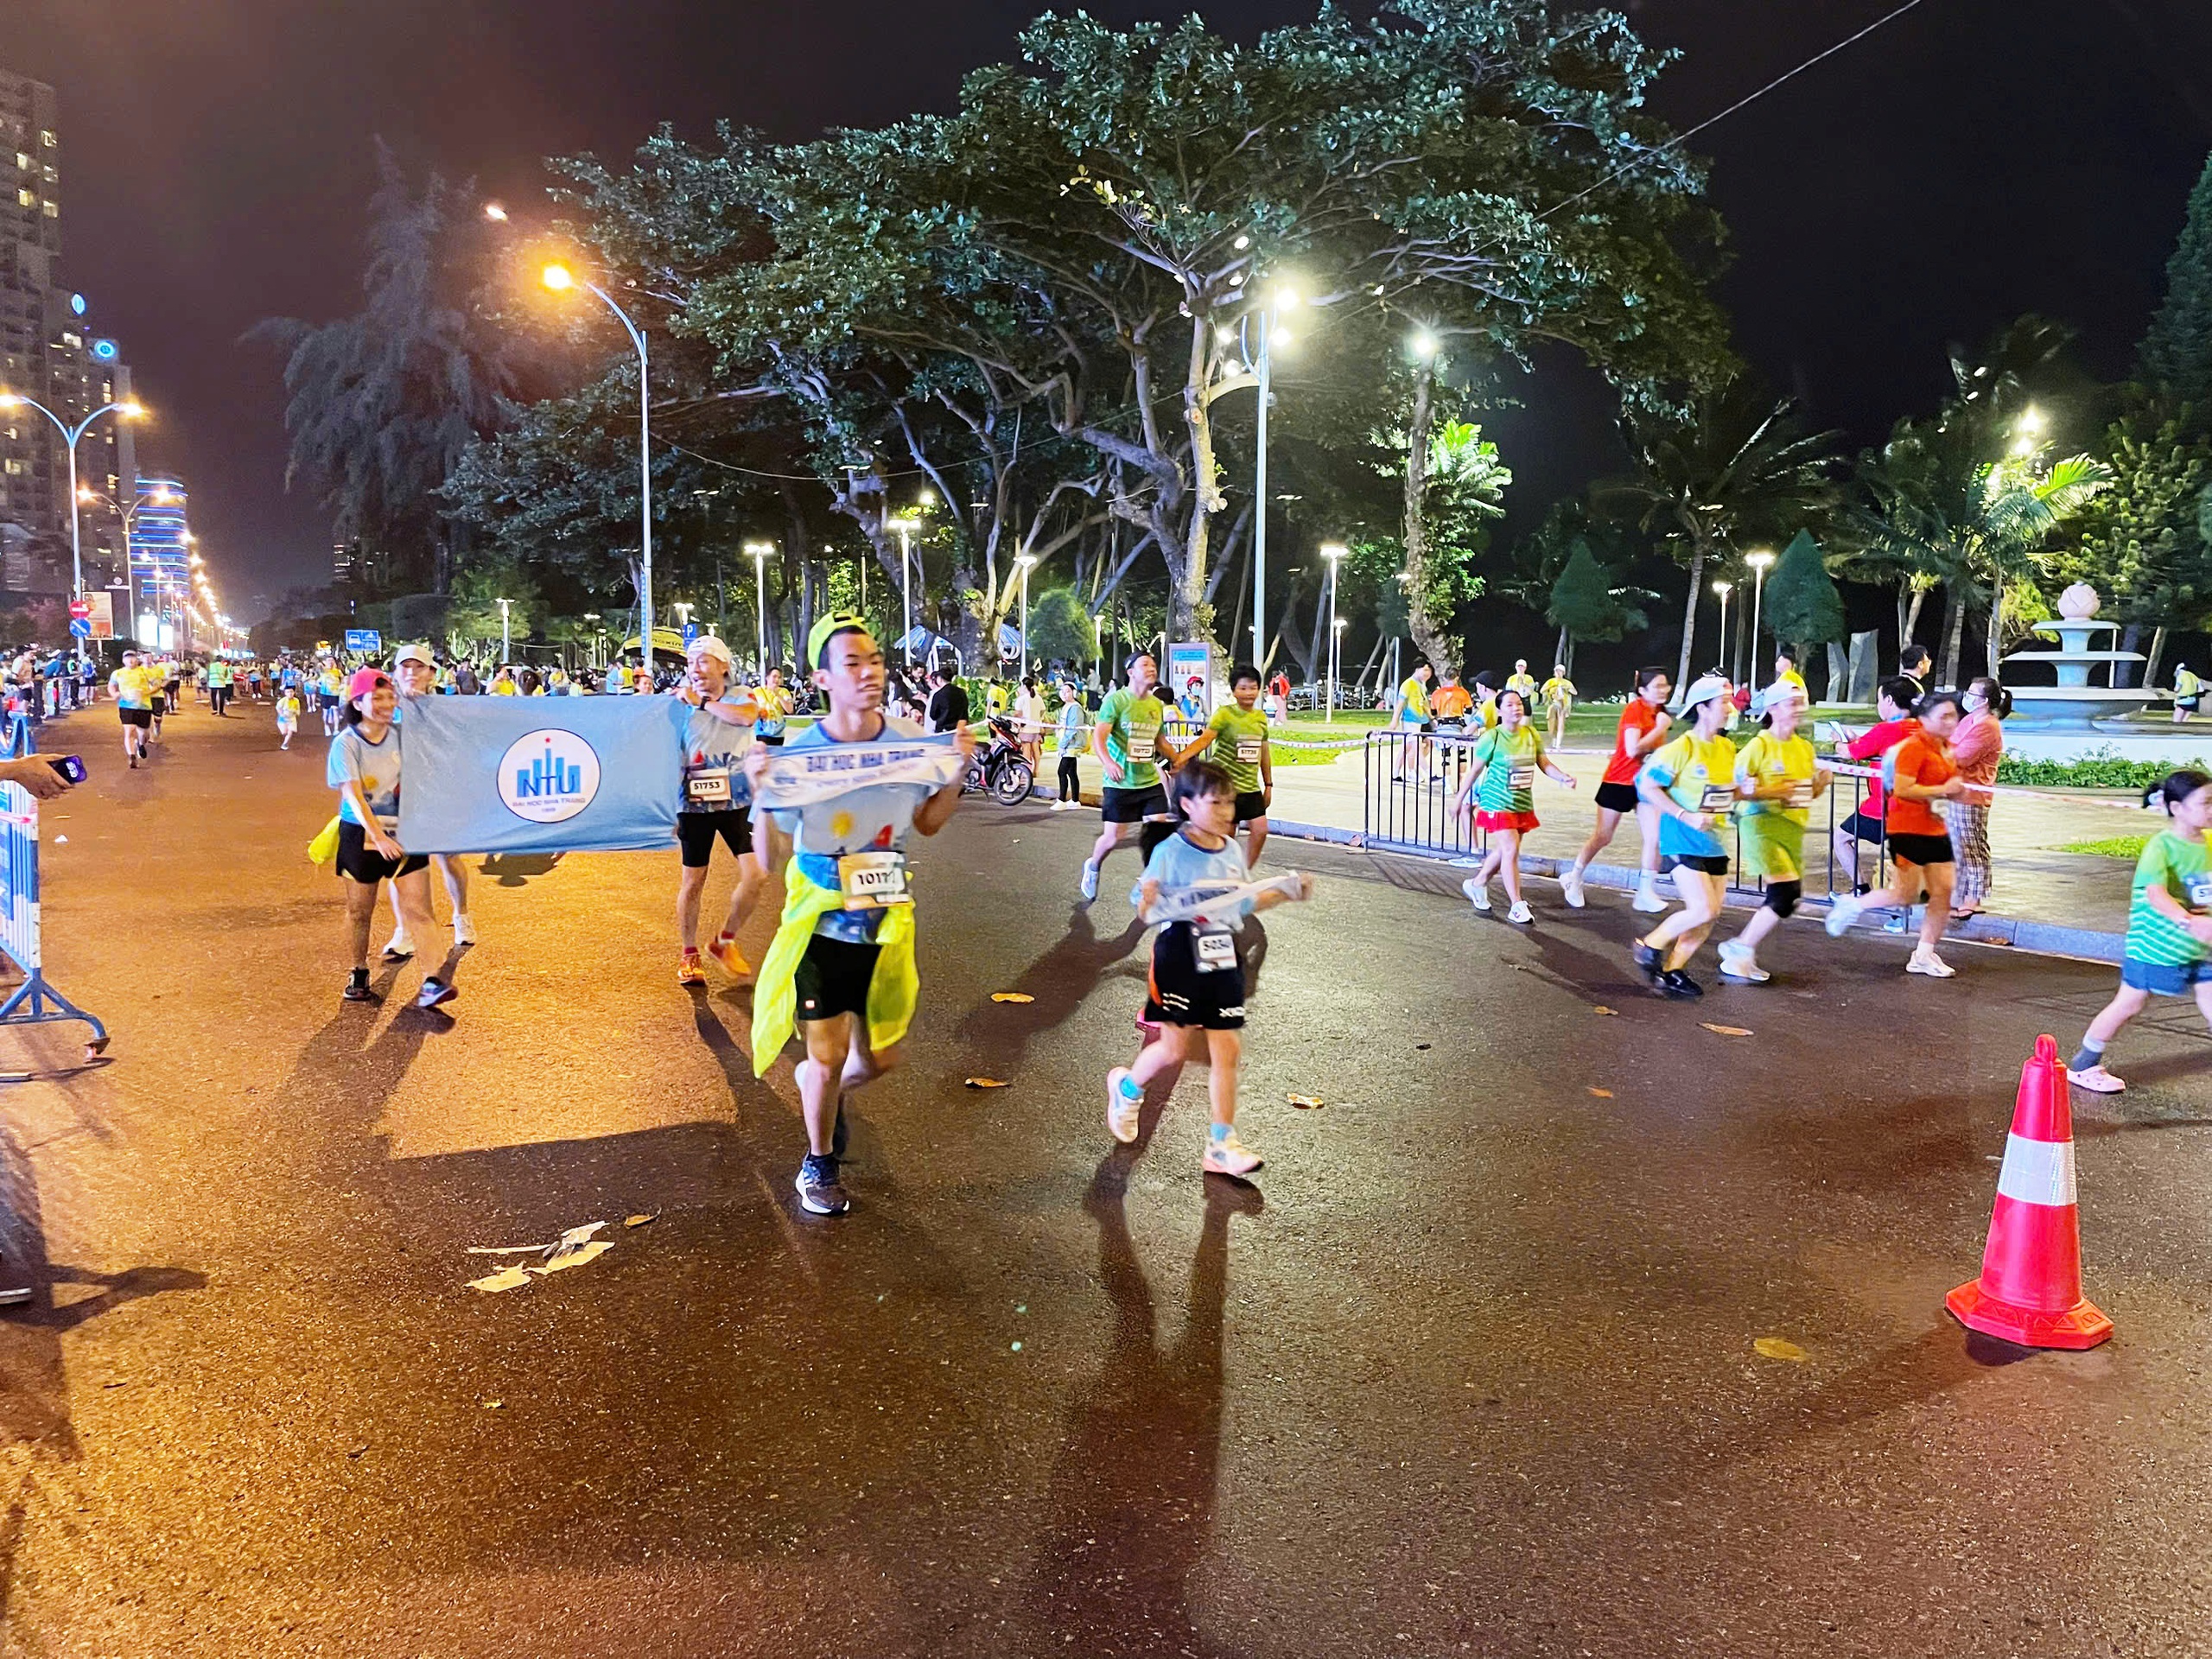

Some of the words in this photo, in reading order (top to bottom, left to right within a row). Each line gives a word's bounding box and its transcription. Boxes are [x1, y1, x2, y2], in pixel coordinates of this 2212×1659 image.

[687, 624, 693, 637] P
[522, 774, 575, 797] NTU
[694, 781, 721, 790] 51753
